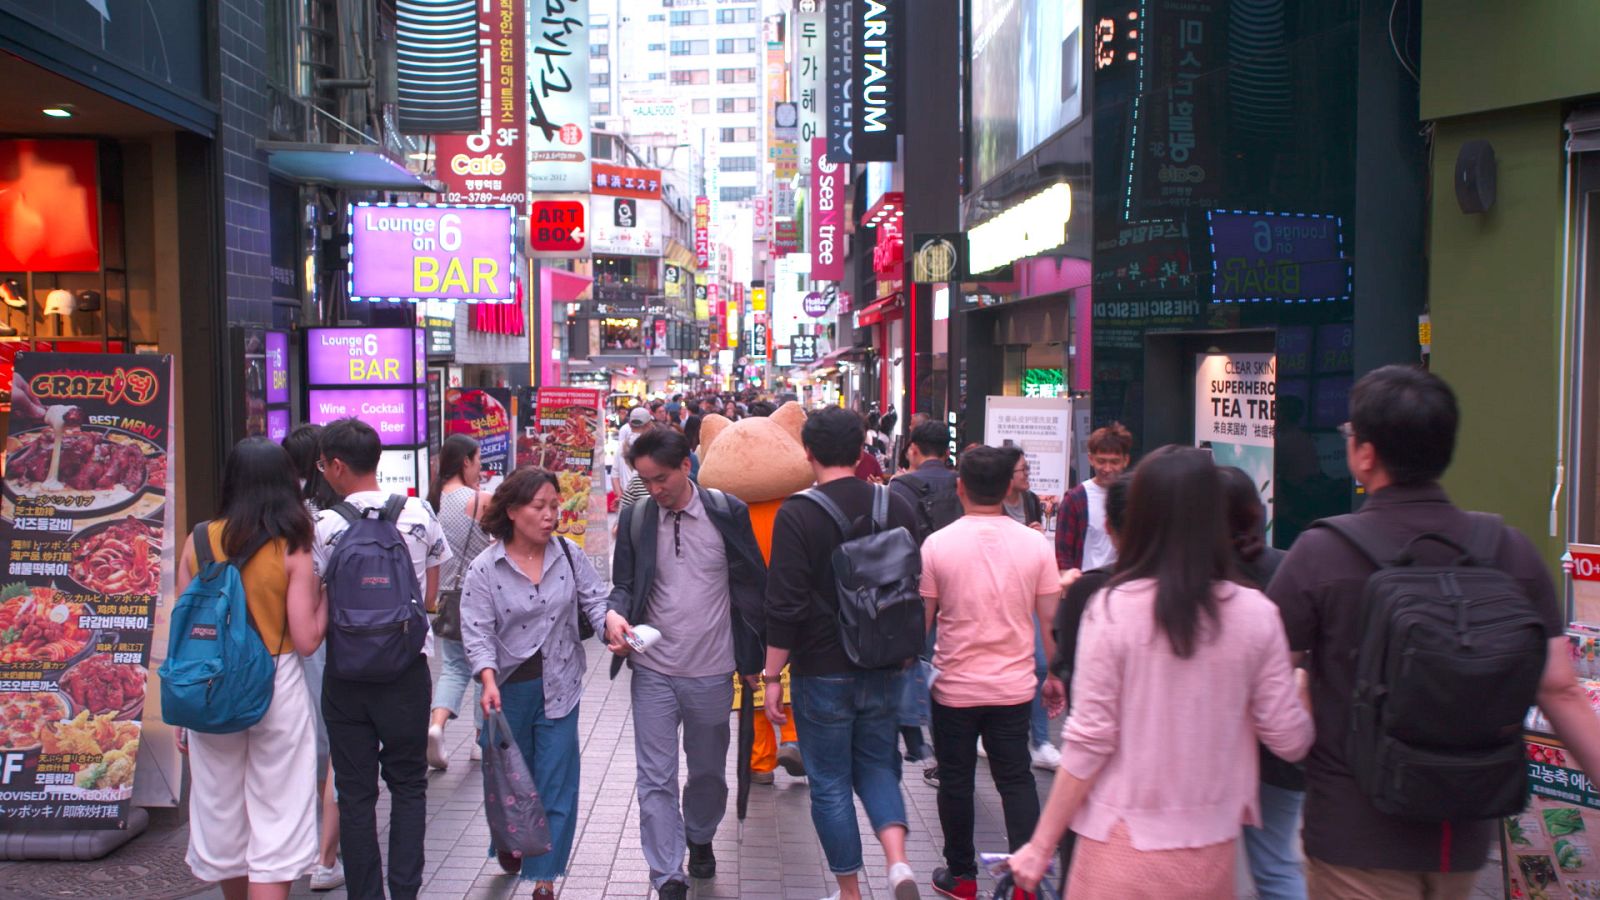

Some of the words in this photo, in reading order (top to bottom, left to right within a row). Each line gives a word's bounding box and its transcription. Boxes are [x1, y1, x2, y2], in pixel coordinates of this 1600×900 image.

[863, 0, 887, 133] ARITAUM
[833, 4, 841, 152] PROFESSIONAL
[496, 128, 519, 146] 3F
[451, 153, 506, 176] Café
[550, 174, 567, 182] 2012
[538, 208, 577, 223] ART
[366, 213, 435, 236] Lounge
[439, 213, 462, 251] 6
[412, 236, 435, 250] on
[413, 257, 499, 294] BAR
[321, 334, 362, 349] Lounge
[364, 334, 378, 355] 6
[349, 347, 363, 356] on
[350, 359, 400, 380] BAR
[1225, 361, 1251, 375] CLEAR
[1254, 361, 1275, 375] SKIN
[31, 368, 124, 405] CRAZY
[1211, 380, 1275, 395] SUPERHERO
[319, 403, 346, 414] Wine
[361, 402, 404, 414] Cocktail
[1211, 397, 1242, 418] TEA
[88, 415, 120, 426] BEST
[121, 417, 162, 440] MENU
[380, 422, 405, 433] Beer
[1213, 421, 1247, 437] 来自英国的
[13, 517, 73, 531] 치즈등갈비
[79, 616, 148, 629] 닭갈비떡볶이
[0, 680, 59, 692] 즈오븐돈까스
[1528, 763, 1569, 787] 고농축
[50, 791, 121, 801] TTEOKBOKKI
